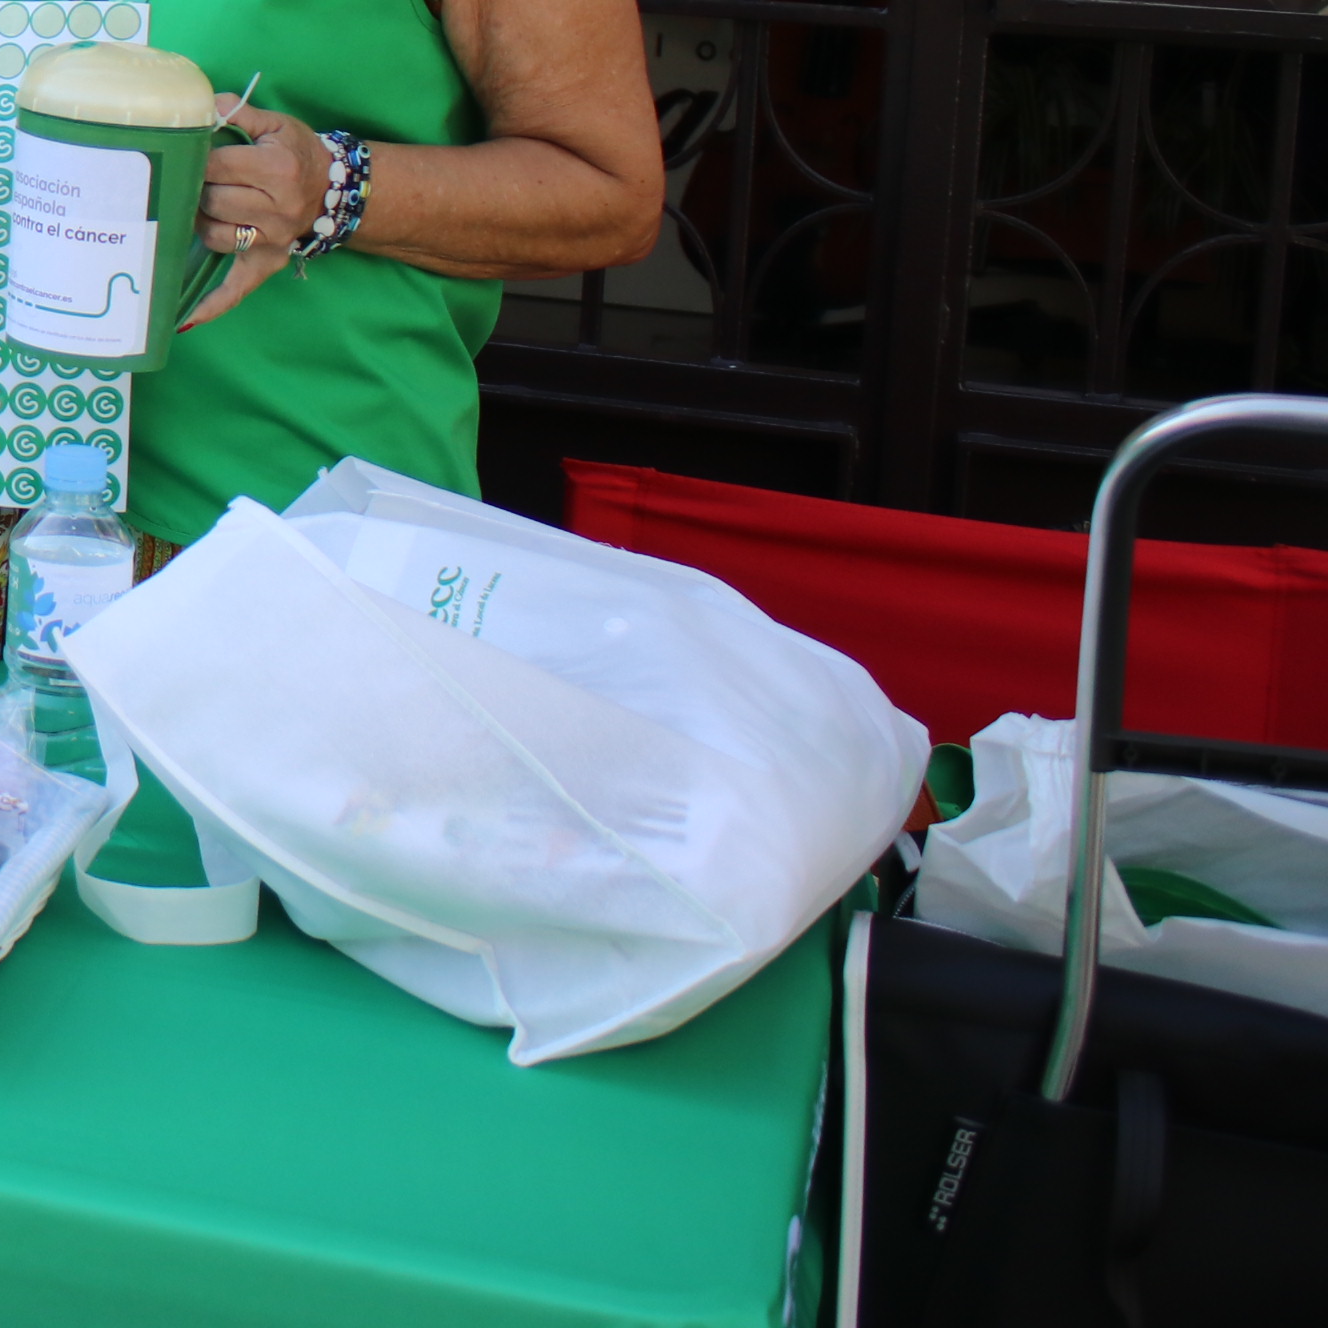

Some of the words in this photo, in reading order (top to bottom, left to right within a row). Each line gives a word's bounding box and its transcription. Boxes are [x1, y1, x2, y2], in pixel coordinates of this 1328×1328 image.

[12, 212, 43, 233] contra
[47, 223, 60, 237] el
[64, 226, 127, 245] cáncer
[935, 1127, 978, 1207] ROLSER
